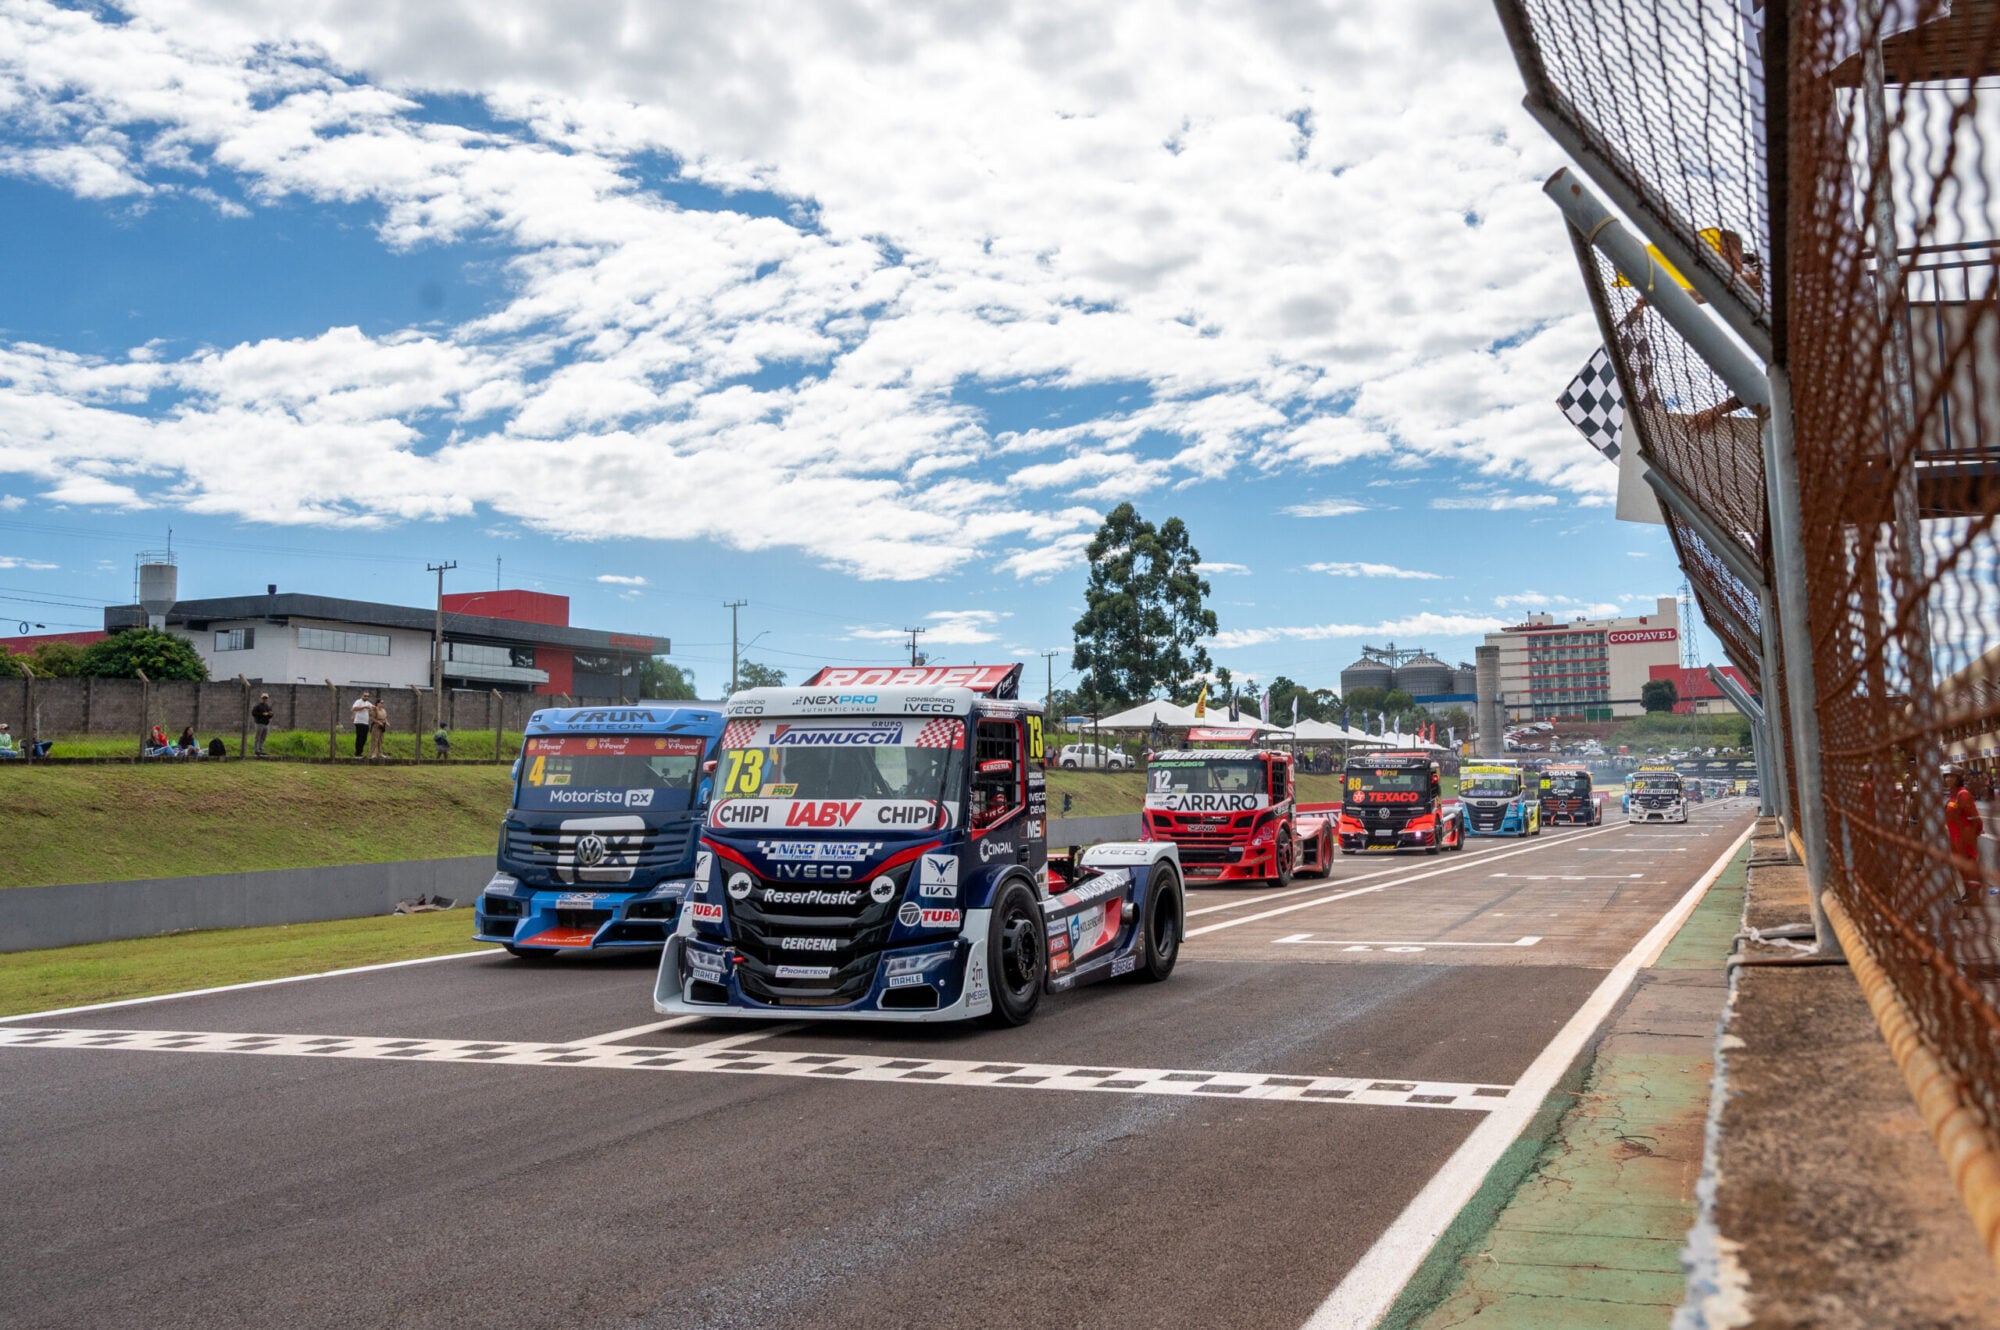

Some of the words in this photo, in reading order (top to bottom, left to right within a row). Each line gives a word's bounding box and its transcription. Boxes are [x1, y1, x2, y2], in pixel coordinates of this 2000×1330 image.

[1610, 631, 1676, 643] COOPAVEL
[815, 668, 996, 687] ROBIEL
[803, 695, 878, 705] NEXPRO
[727, 706, 763, 714] VECO
[904, 704, 954, 712] IVECO
[567, 710, 656, 722] FRUM
[1027, 716, 1044, 758] 73
[528, 756, 546, 786] 4
[724, 750, 764, 793] 73
[1154, 770, 1172, 789] 12
[1348, 778, 1362, 790] 88
[550, 789, 622, 804] Motorista
[630, 792, 650, 806] px
[1029, 792, 1046, 801] IVECO
[1166, 795, 1258, 811] CARRARO
[1368, 792, 1419, 803] TEXACO
[720, 806, 769, 823] CHIPI
[878, 806, 935, 824] CHIPI
[1091, 848, 1148, 856] IVECO
[776, 864, 852, 879] IVECO
[764, 889, 858, 905] ReserPlastic
[922, 910, 960, 922] TUBA
[782, 938, 837, 952] CERCENA
[694, 968, 720, 982] MAHLE
[780, 967, 828, 975] PROMETEON
[891, 974, 922, 986] MAHLE
